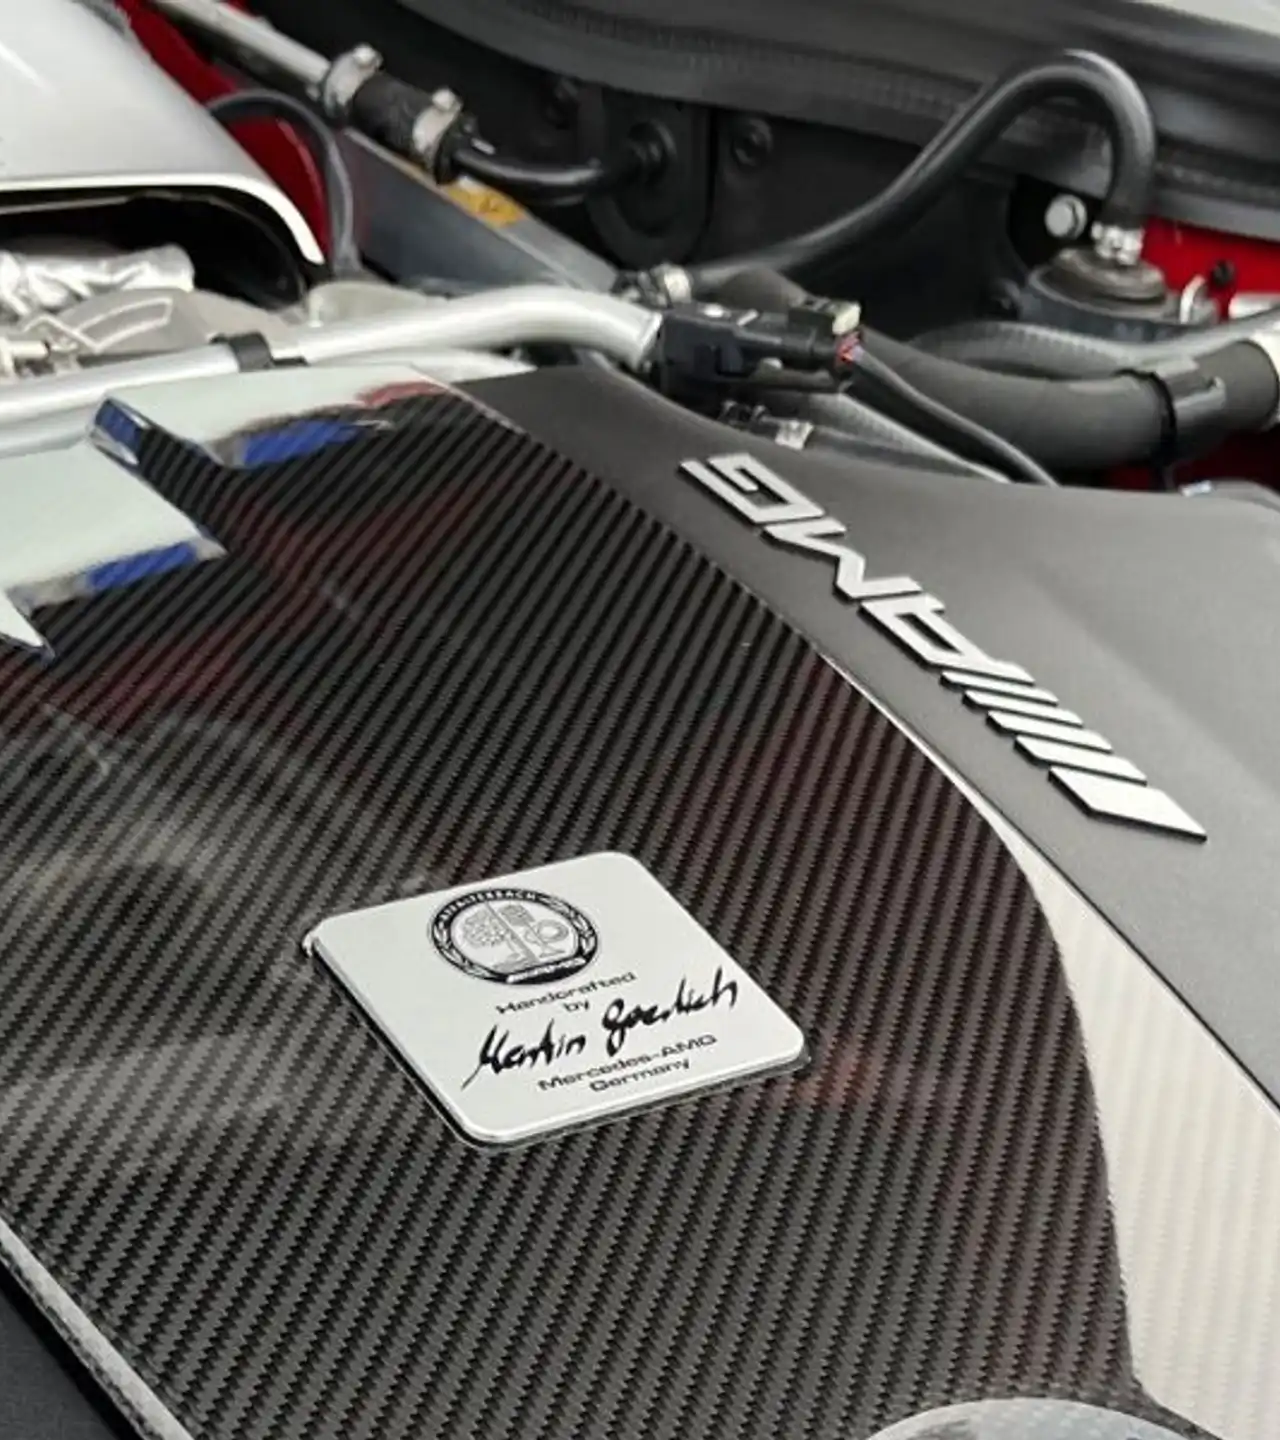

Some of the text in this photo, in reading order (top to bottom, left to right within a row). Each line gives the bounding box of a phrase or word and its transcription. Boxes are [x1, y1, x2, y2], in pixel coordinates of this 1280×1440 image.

[495, 971, 638, 1015] Handcrafted
[562, 998, 591, 1013] by
[537, 1034, 718, 1091] Mercedes-AMG
[588, 1058, 691, 1093] Germany
